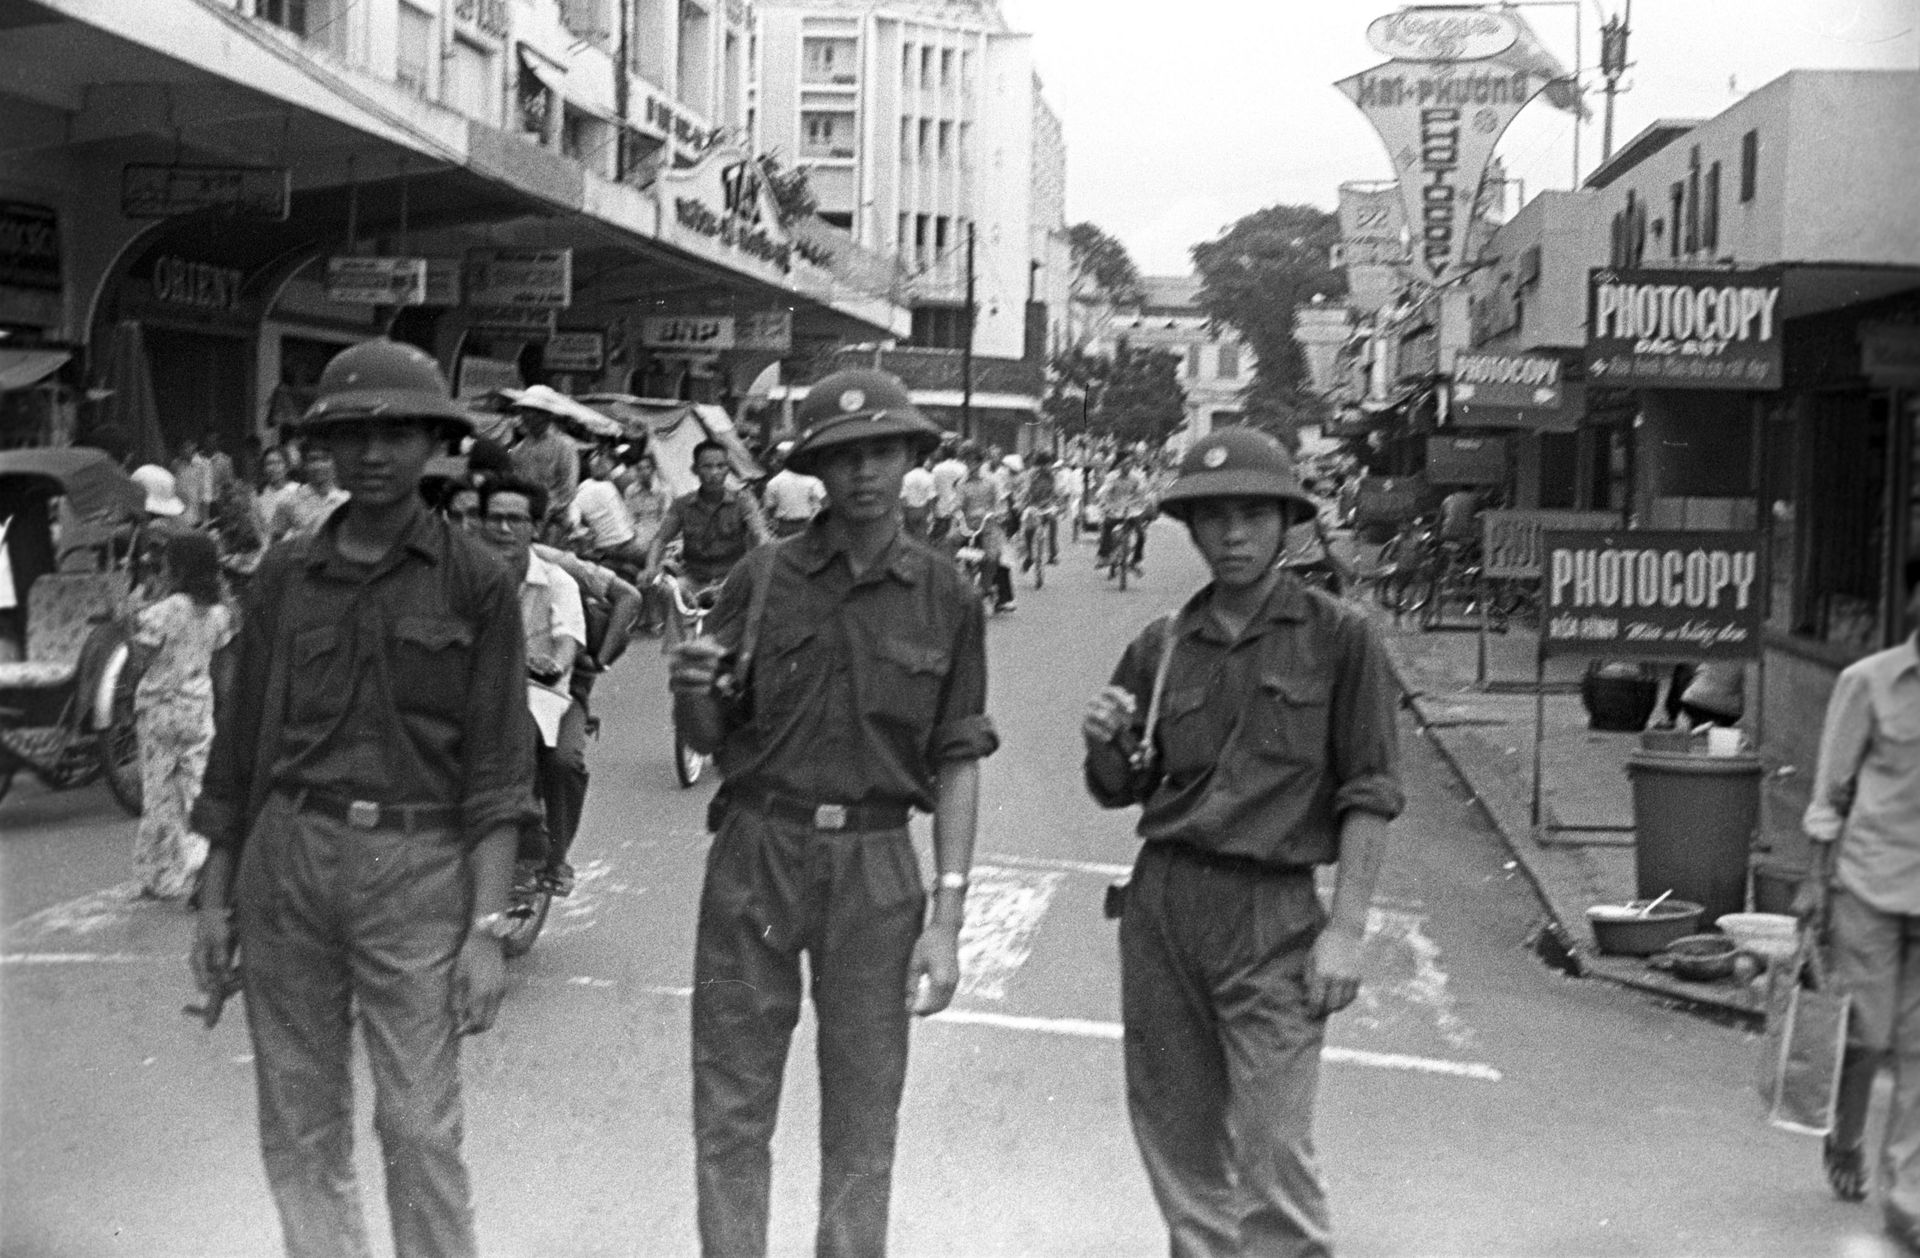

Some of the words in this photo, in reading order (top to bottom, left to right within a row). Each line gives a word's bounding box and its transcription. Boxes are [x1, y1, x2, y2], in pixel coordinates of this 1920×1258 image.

[153, 253, 243, 311] ORIENT
[1595, 284, 1780, 342] PHOTOCOPY
[1454, 355, 1560, 385] PHOTOCOPY
[1551, 548, 1756, 610] PHOTOCOPY
